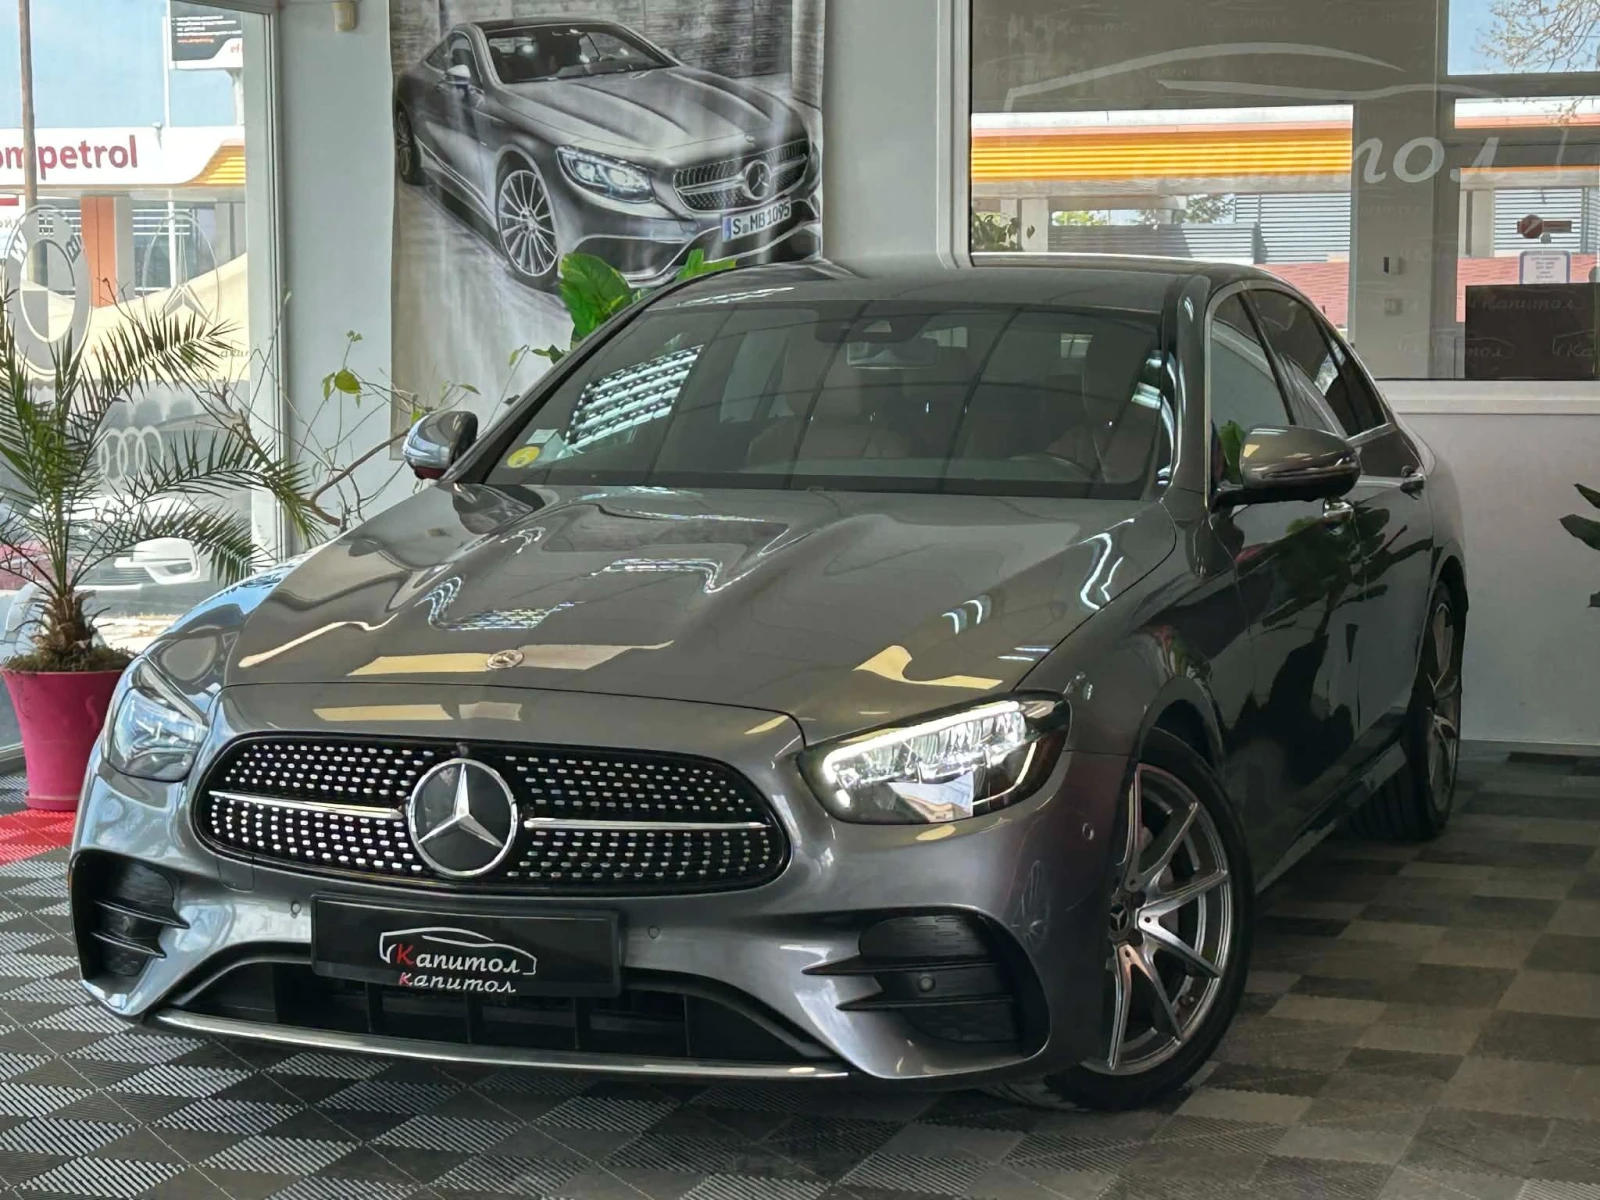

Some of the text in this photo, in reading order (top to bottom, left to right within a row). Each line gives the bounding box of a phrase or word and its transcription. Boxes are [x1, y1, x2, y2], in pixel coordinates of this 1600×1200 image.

[0, 135, 138, 180] mpetrol
[733, 218, 741, 235] S
[396, 943, 520, 974] Капитол
